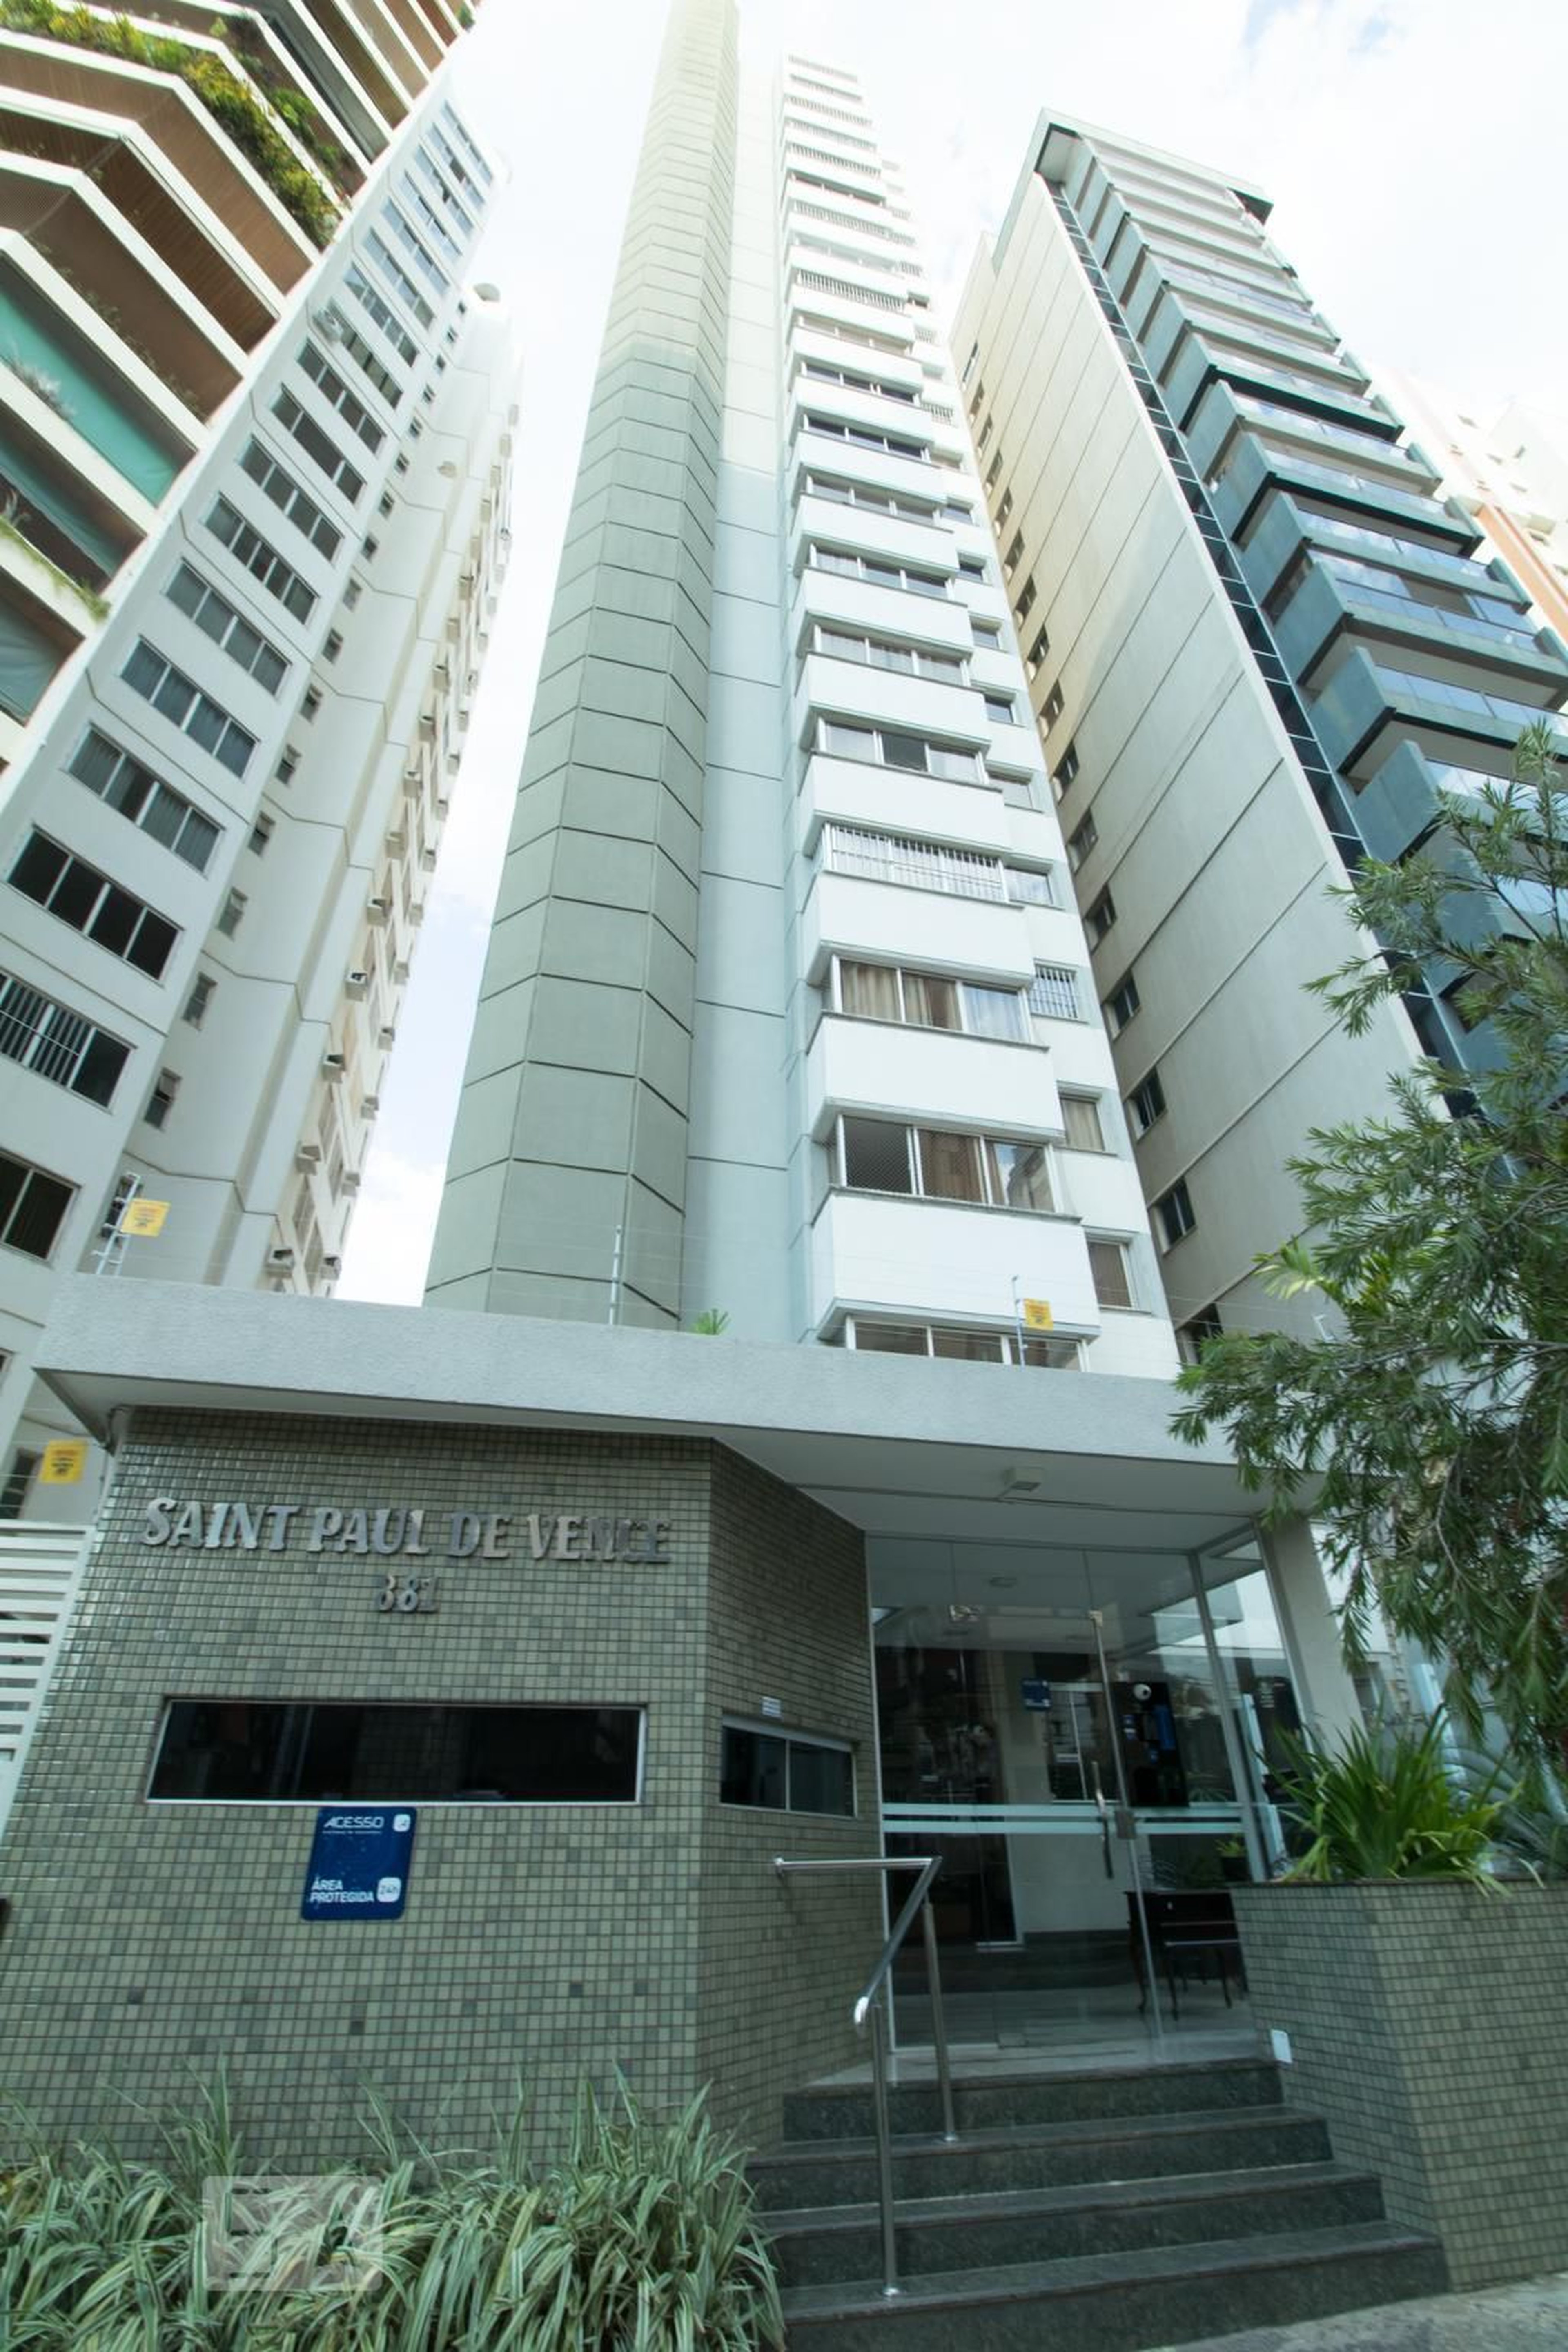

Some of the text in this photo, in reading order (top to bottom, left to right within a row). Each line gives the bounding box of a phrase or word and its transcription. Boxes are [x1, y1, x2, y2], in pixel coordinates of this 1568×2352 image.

[140, 1497, 672, 1563] SAINT PAUL DE VENCE
[324, 1816, 385, 1828] ACESSO
[310, 1891, 374, 1903] PROTEGIDA
